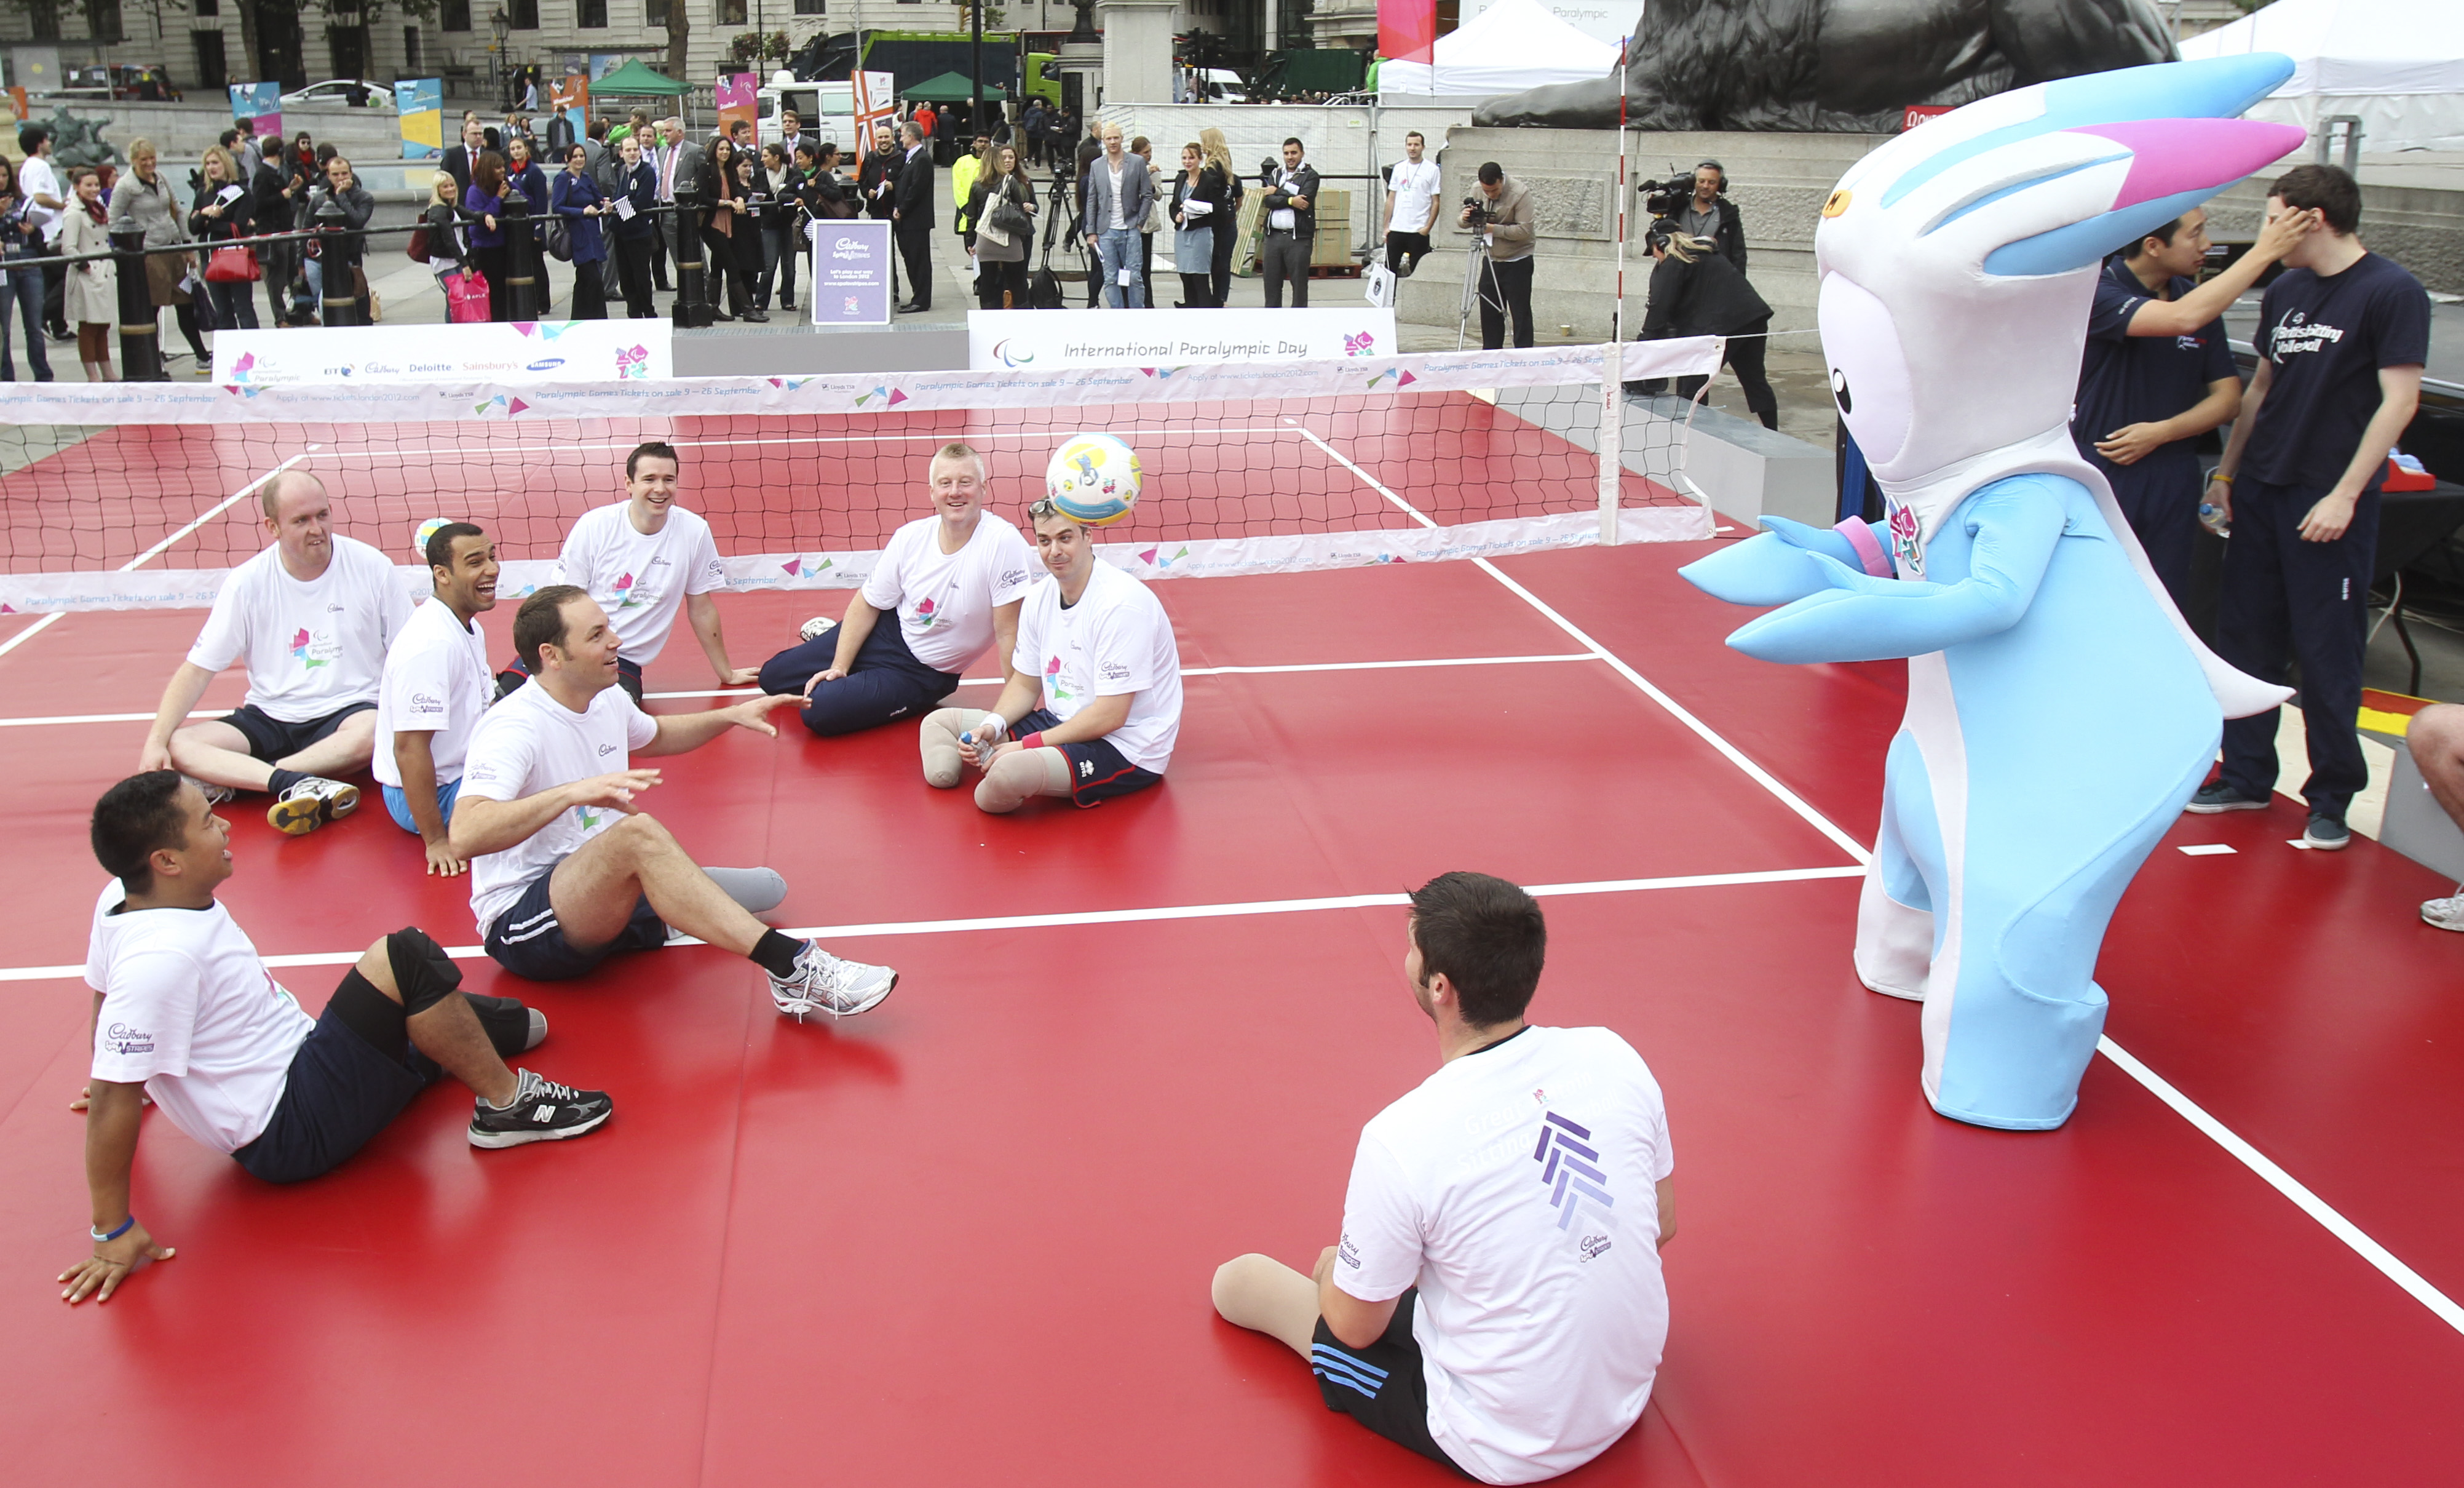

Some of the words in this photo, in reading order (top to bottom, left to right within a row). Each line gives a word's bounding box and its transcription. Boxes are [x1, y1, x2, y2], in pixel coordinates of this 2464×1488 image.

[835, 237, 869, 252] Cadbury
[1064, 341, 1173, 357] International
[1179, 340, 1271, 359] Paralympic
[1277, 340, 1308, 358] Day
[365, 362, 400, 375] Cadbury
[462, 360, 518, 372] Sainsbury's
[1424, 362, 1469, 373] Paralympic
[1500, 359, 1527, 368] Tickets
[254, 373, 300, 383] Paralympic
[1187, 374, 1208, 383] Apply
[1220, 370, 1318, 380] www.tickets.london2012.com
[915, 382, 964, 391] Paralympic
[1088, 377, 1133, 387] September
[69, 395, 99, 404] Tickets
[154, 394, 164, 403] 26
[168, 394, 217, 405] September
[276, 394, 298, 403] Apply
[536, 391, 586, 400] Paralympic
[620, 389, 649, 397] Tickets
[714, 387, 762, 397] September
[1488, 541, 1514, 549] Tickets
[1571, 532, 1600, 541] Septem
[1186, 562, 1206, 571] Apply
[733, 576, 778, 585] September
[26, 597, 77, 606] Paralympic
[112, 594, 141, 602] Tickets
[159, 592, 176, 601] sale
[1101, 661, 1128, 672] Cadbury
[413, 693, 442, 705] Cadbury
[108, 1022, 153, 1042] Cadbury
[533, 1104, 556, 1123] N
[1580, 1235, 1608, 1251] Cadbury
